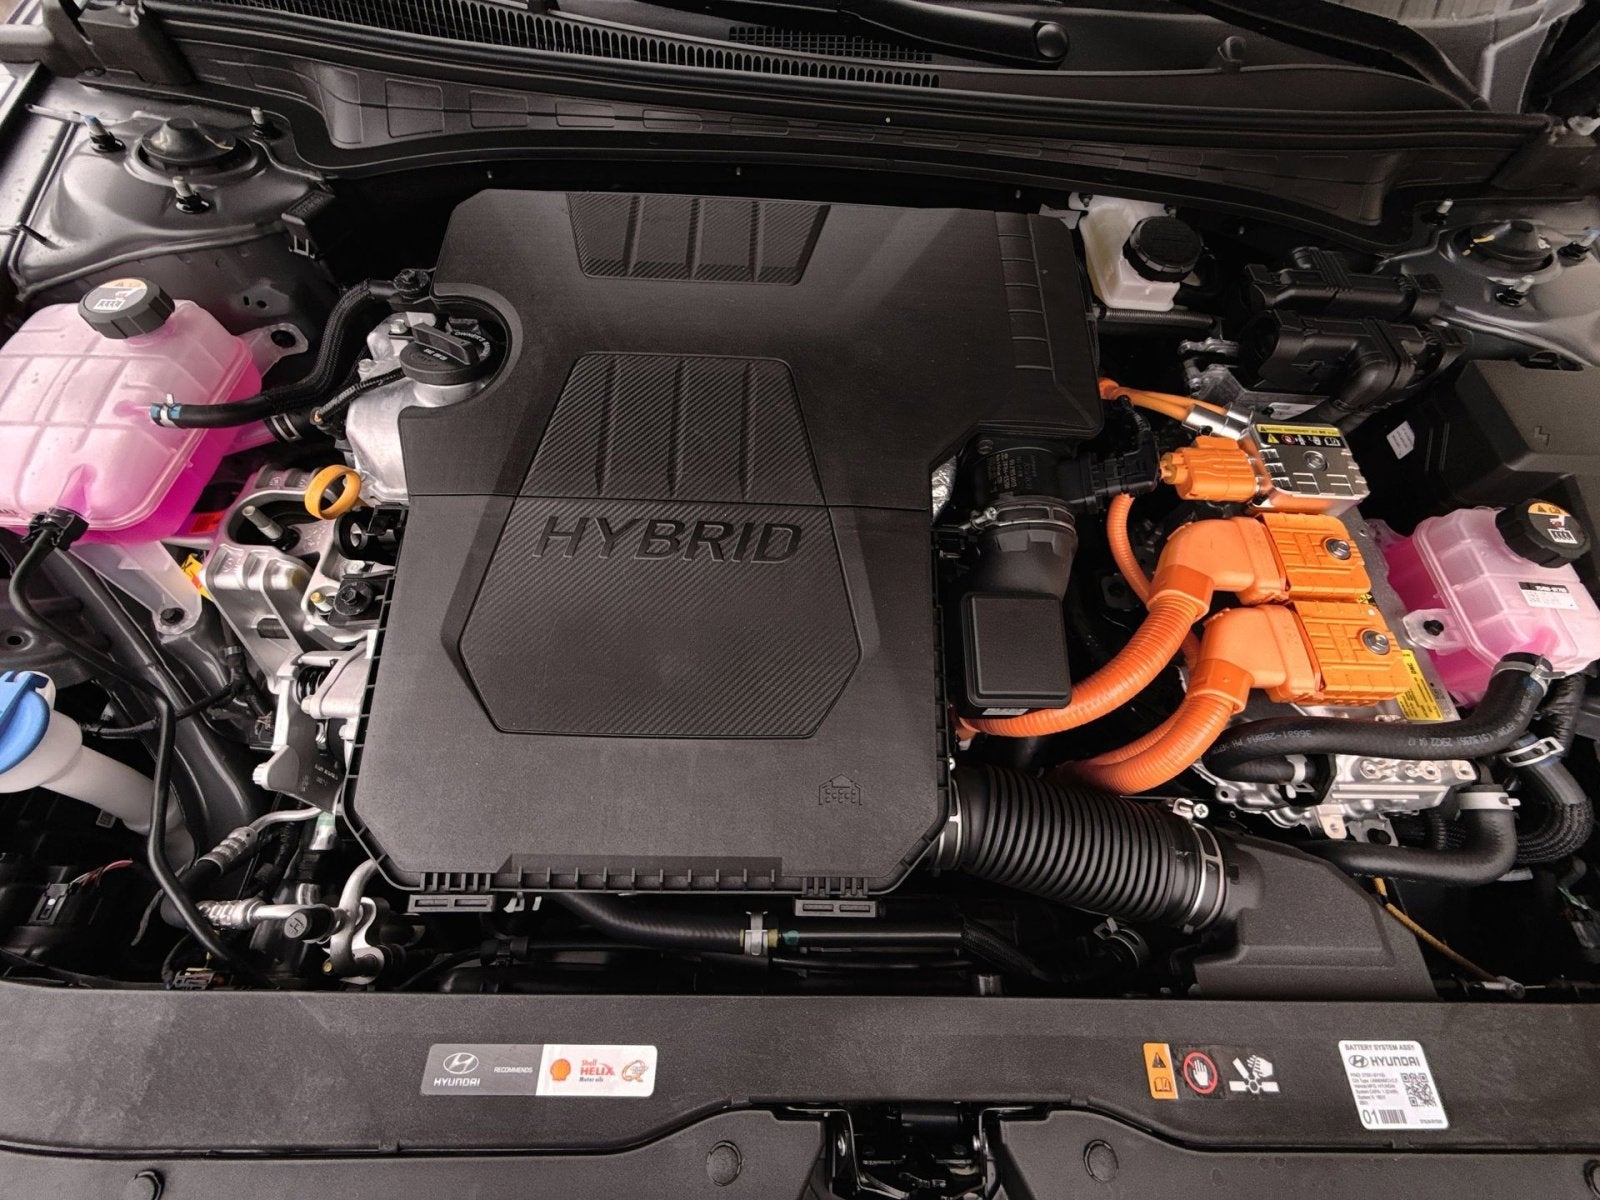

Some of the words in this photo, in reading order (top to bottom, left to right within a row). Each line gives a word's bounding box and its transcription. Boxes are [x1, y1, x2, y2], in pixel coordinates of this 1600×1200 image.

[532, 515, 802, 564] HYBRID
[581, 1059, 598, 1067] Shell
[1369, 1056, 1421, 1067] HYUNDAI
[493, 1066, 534, 1074] RECOMMENDS
[579, 1065, 615, 1076] HELIX
[433, 1077, 481, 1087] HYUNDAI
[1362, 1109, 1380, 1125] 01
